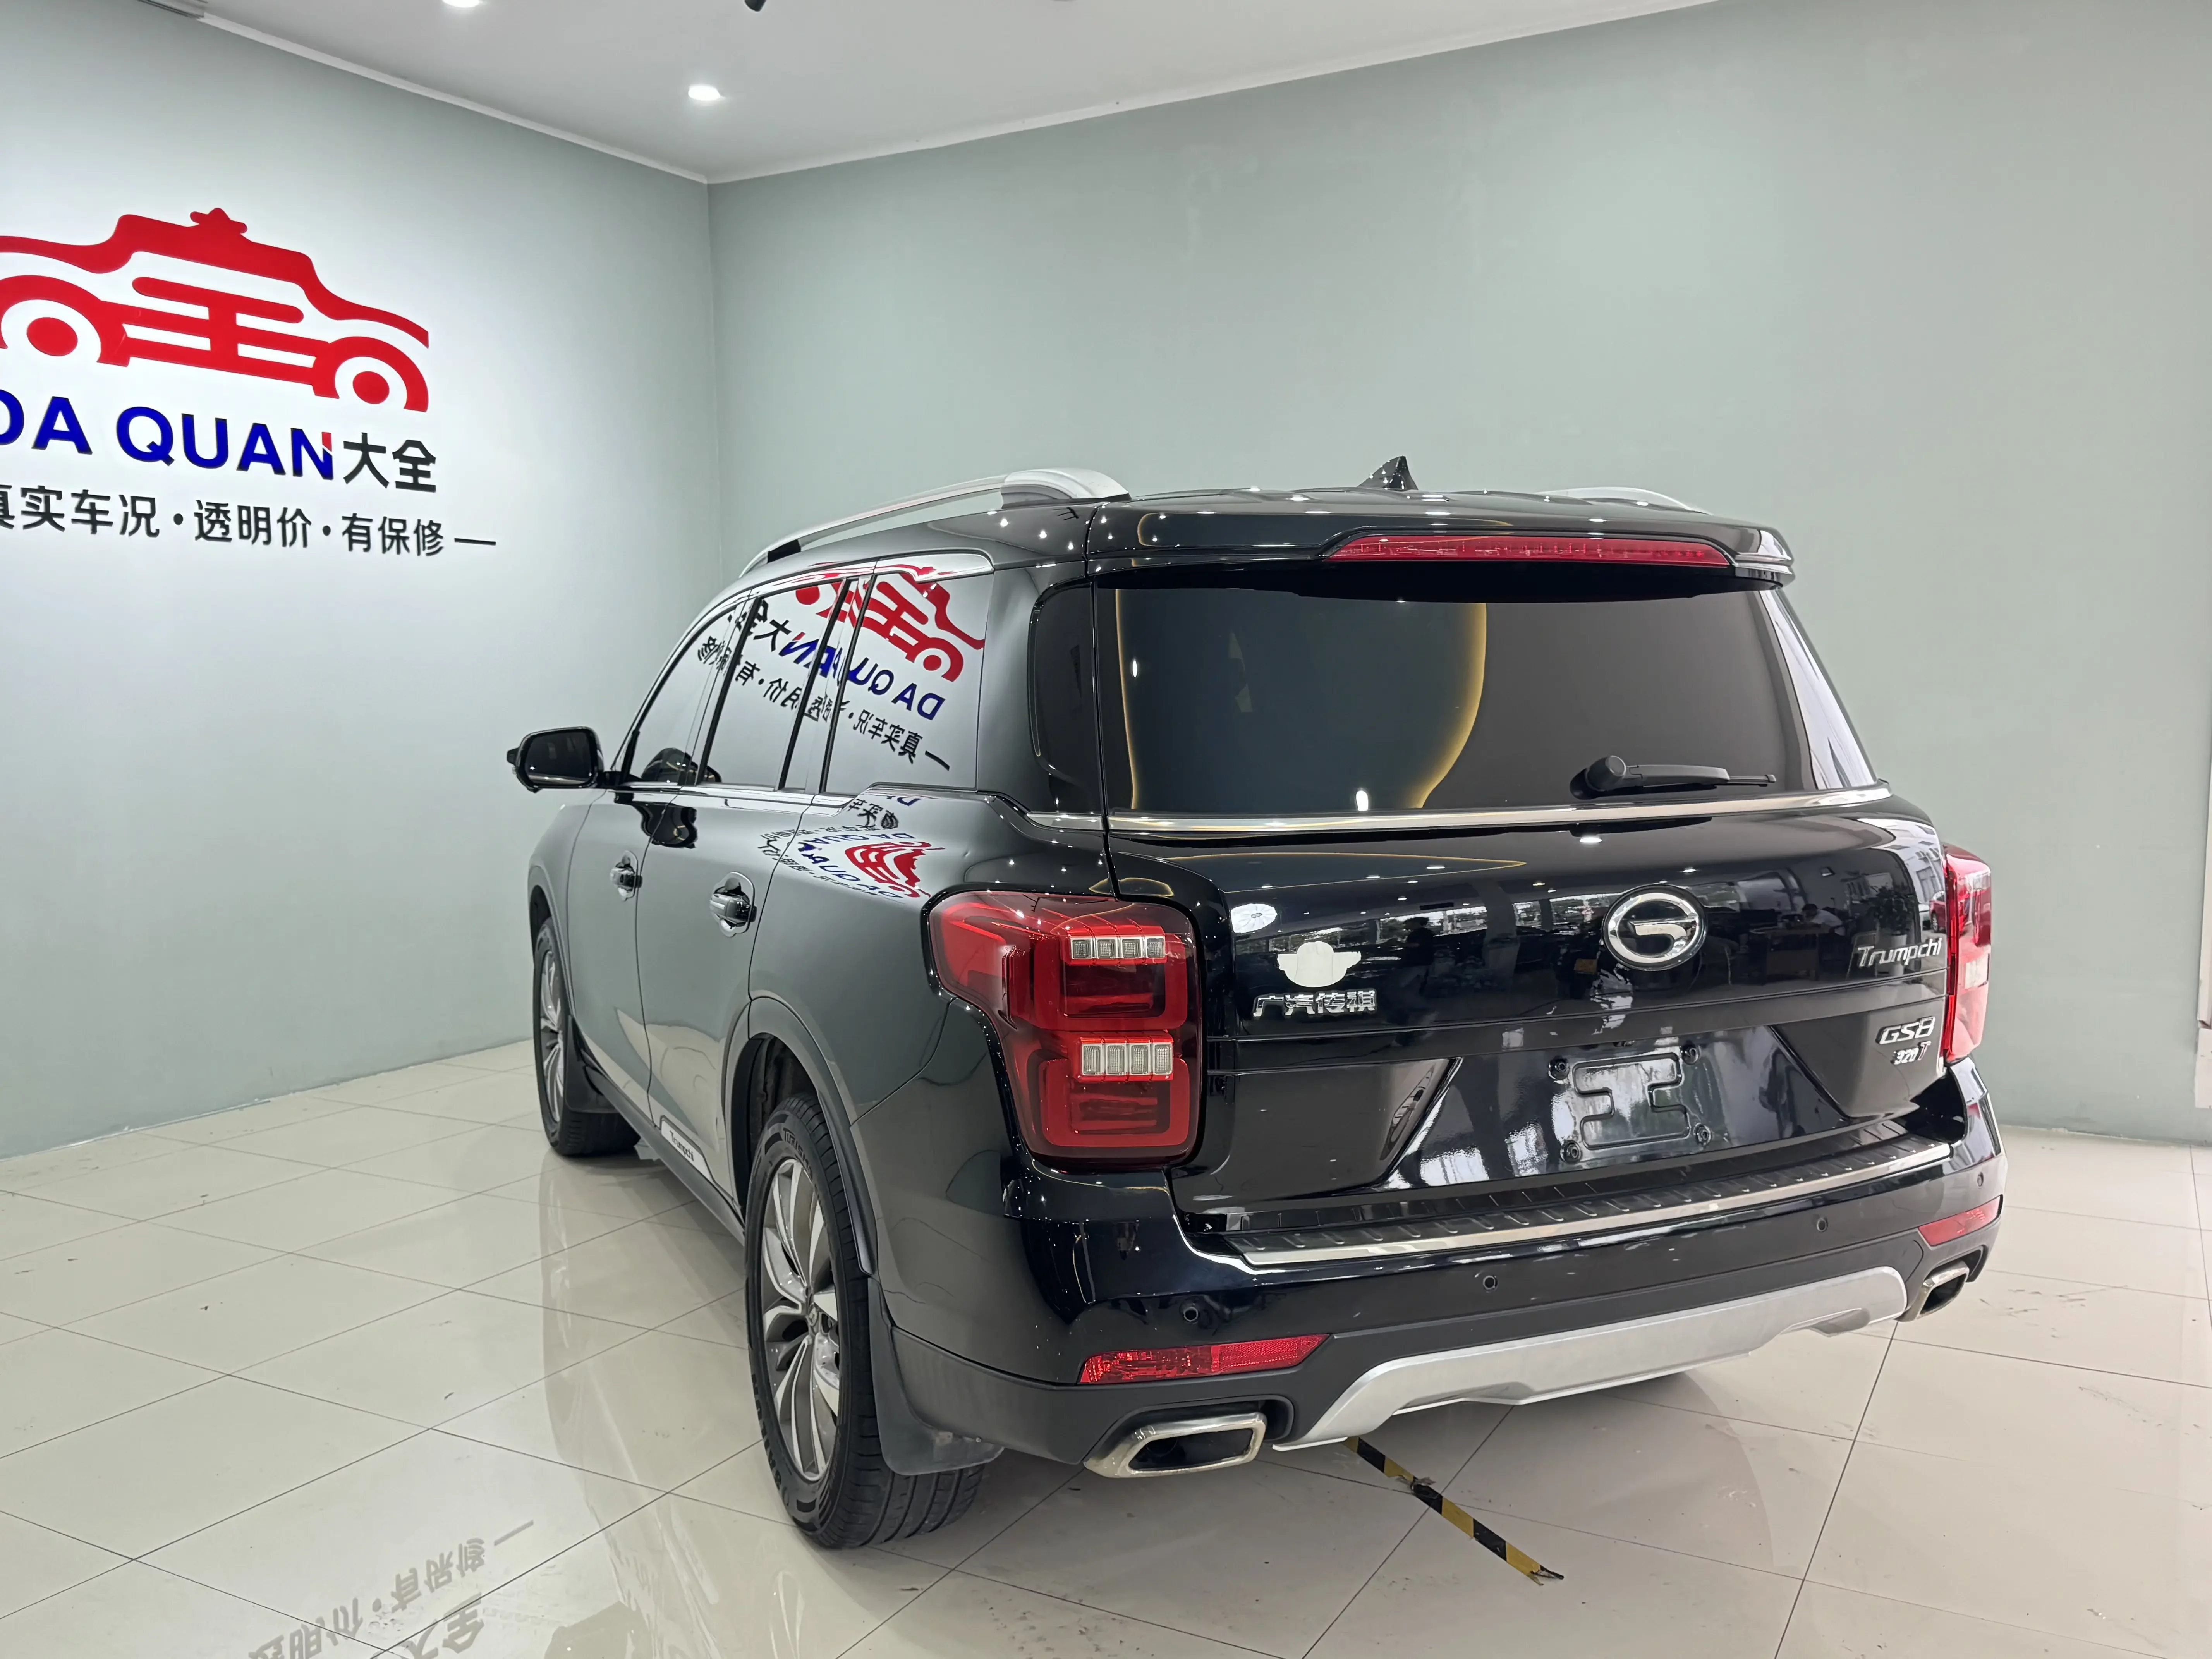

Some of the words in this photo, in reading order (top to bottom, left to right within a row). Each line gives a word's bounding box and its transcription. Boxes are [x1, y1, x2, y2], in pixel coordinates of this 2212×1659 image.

[116, 406, 334, 481] QUAN
[343, 432, 437, 493] 大全
[1858, 937, 1943, 967] Trumpchi
[1253, 989, 1376, 1017] 广汽传祺
[1879, 1016, 1936, 1045] GS8
[669, 1130, 694, 1162] Trumpchi
